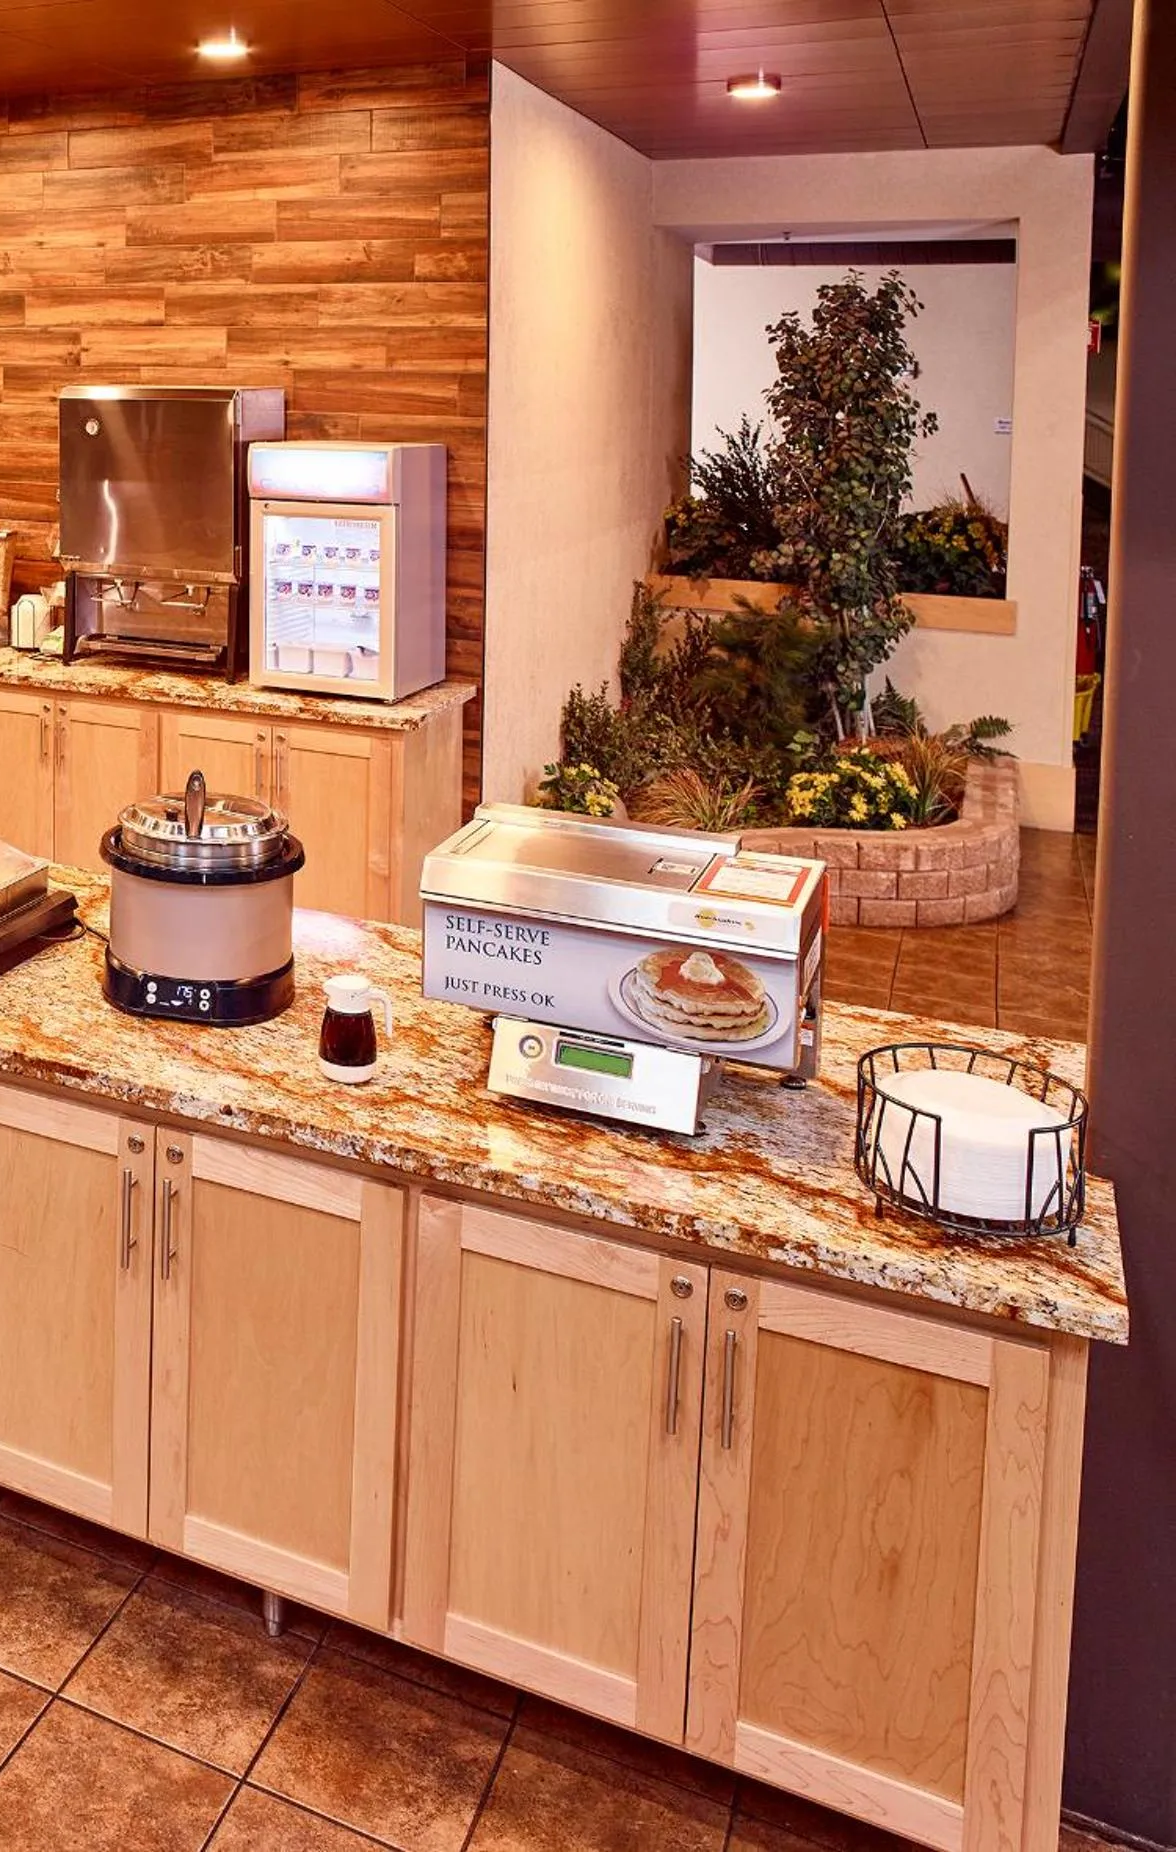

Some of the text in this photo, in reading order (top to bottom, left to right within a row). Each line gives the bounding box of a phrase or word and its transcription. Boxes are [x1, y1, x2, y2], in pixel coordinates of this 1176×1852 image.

[445, 914, 551, 947] SELF-SERVE
[445, 935, 543, 966] PANCAKES
[444, 975, 556, 1009] JUST PRESS OK
